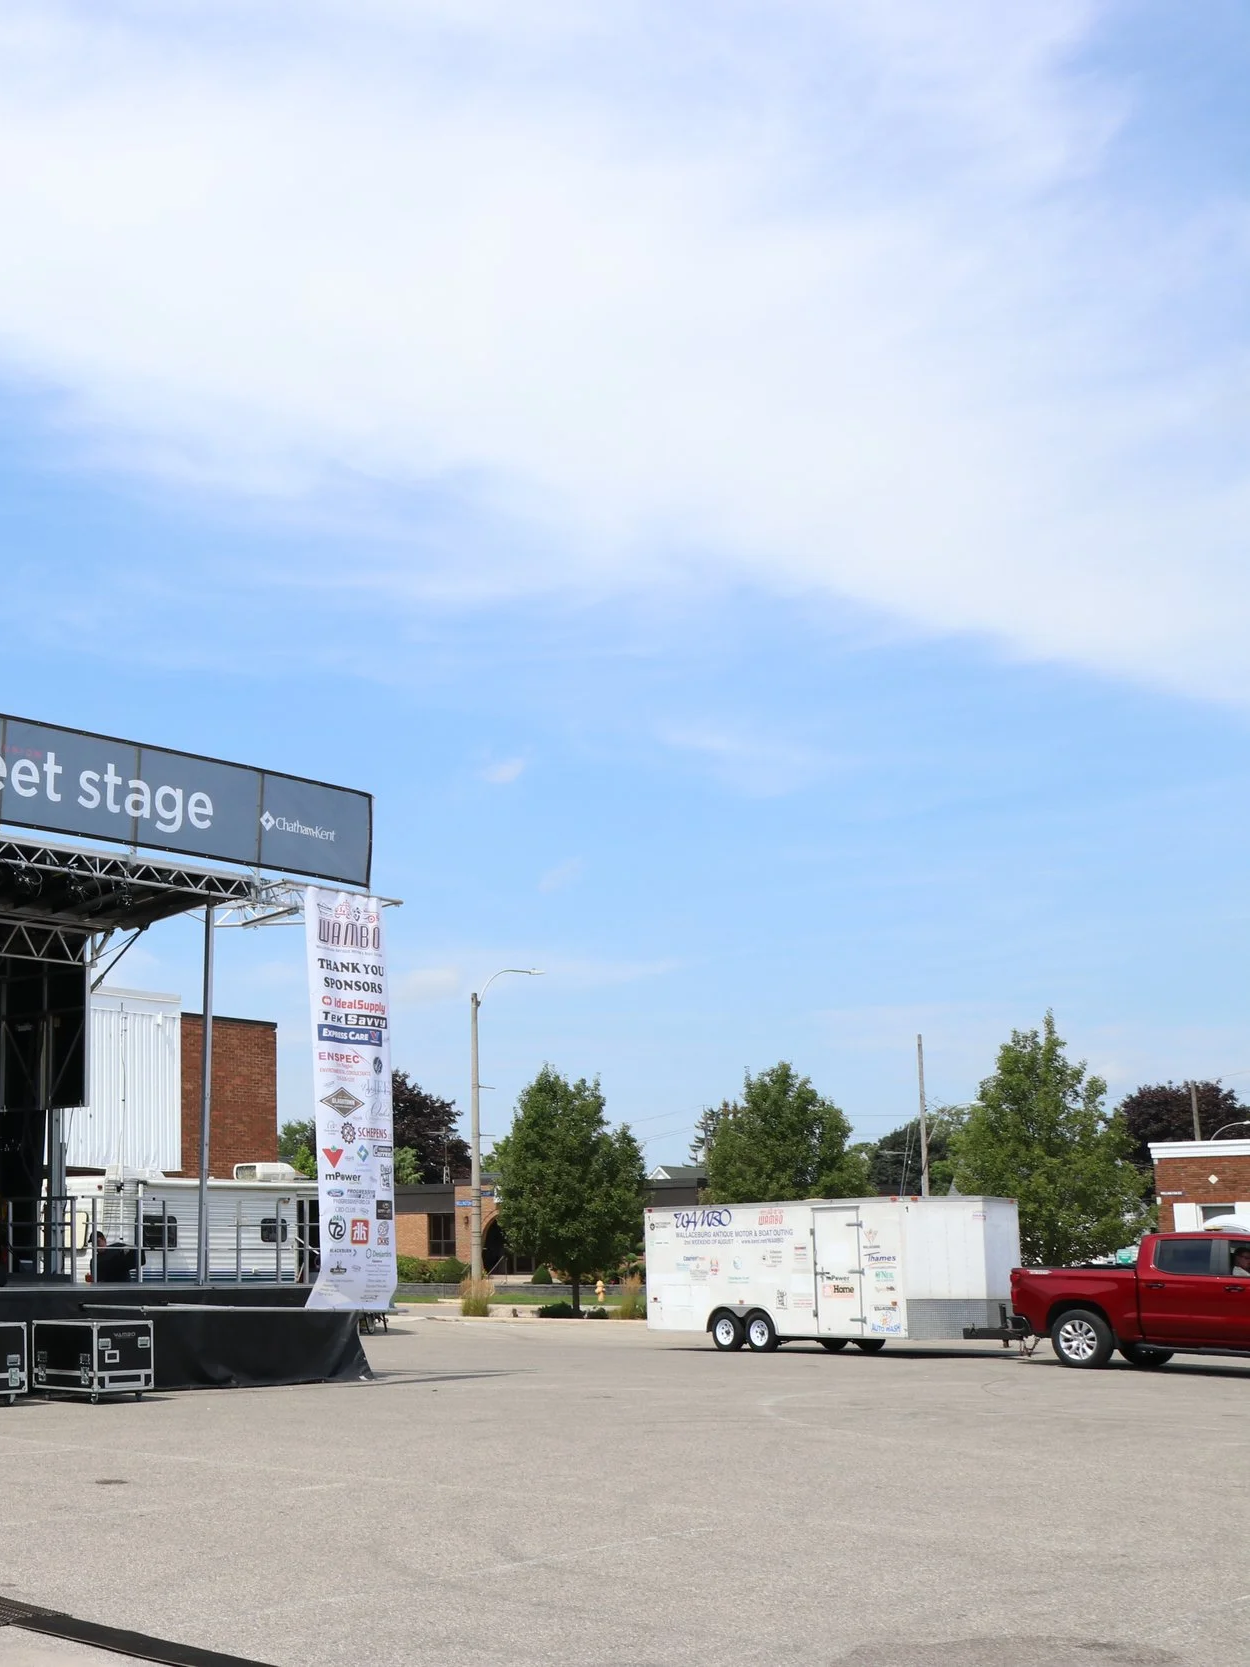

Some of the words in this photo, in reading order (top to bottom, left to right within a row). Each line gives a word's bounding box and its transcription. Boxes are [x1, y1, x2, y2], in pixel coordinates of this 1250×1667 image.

[77, 762, 214, 833] stage
[275, 816, 336, 842] Chatham-Kent
[318, 917, 381, 951] WAMBO
[317, 957, 361, 974] THANK
[362, 963, 384, 977] YOU
[323, 976, 383, 994] SPONSORS
[334, 997, 386, 1015] IdealSupply
[348, 1031, 369, 1041] CARE
[318, 1051, 360, 1064] ENSPEC
[357, 1127, 388, 1139] SCHEPENS
[325, 1172, 361, 1182] mPower
[674, 1208, 732, 1231] WAMBO
[758, 1214, 784, 1226] WAMBO
[676, 1230, 712, 1238] WALLACEBURG
[712, 1230, 734, 1238] ANTIQUE
[735, 1229, 753, 1237] MOTOR
[773, 1228, 794, 1236] OUTING
[866, 1252, 897, 1262] Thames
[833, 1285, 855, 1294] Home
